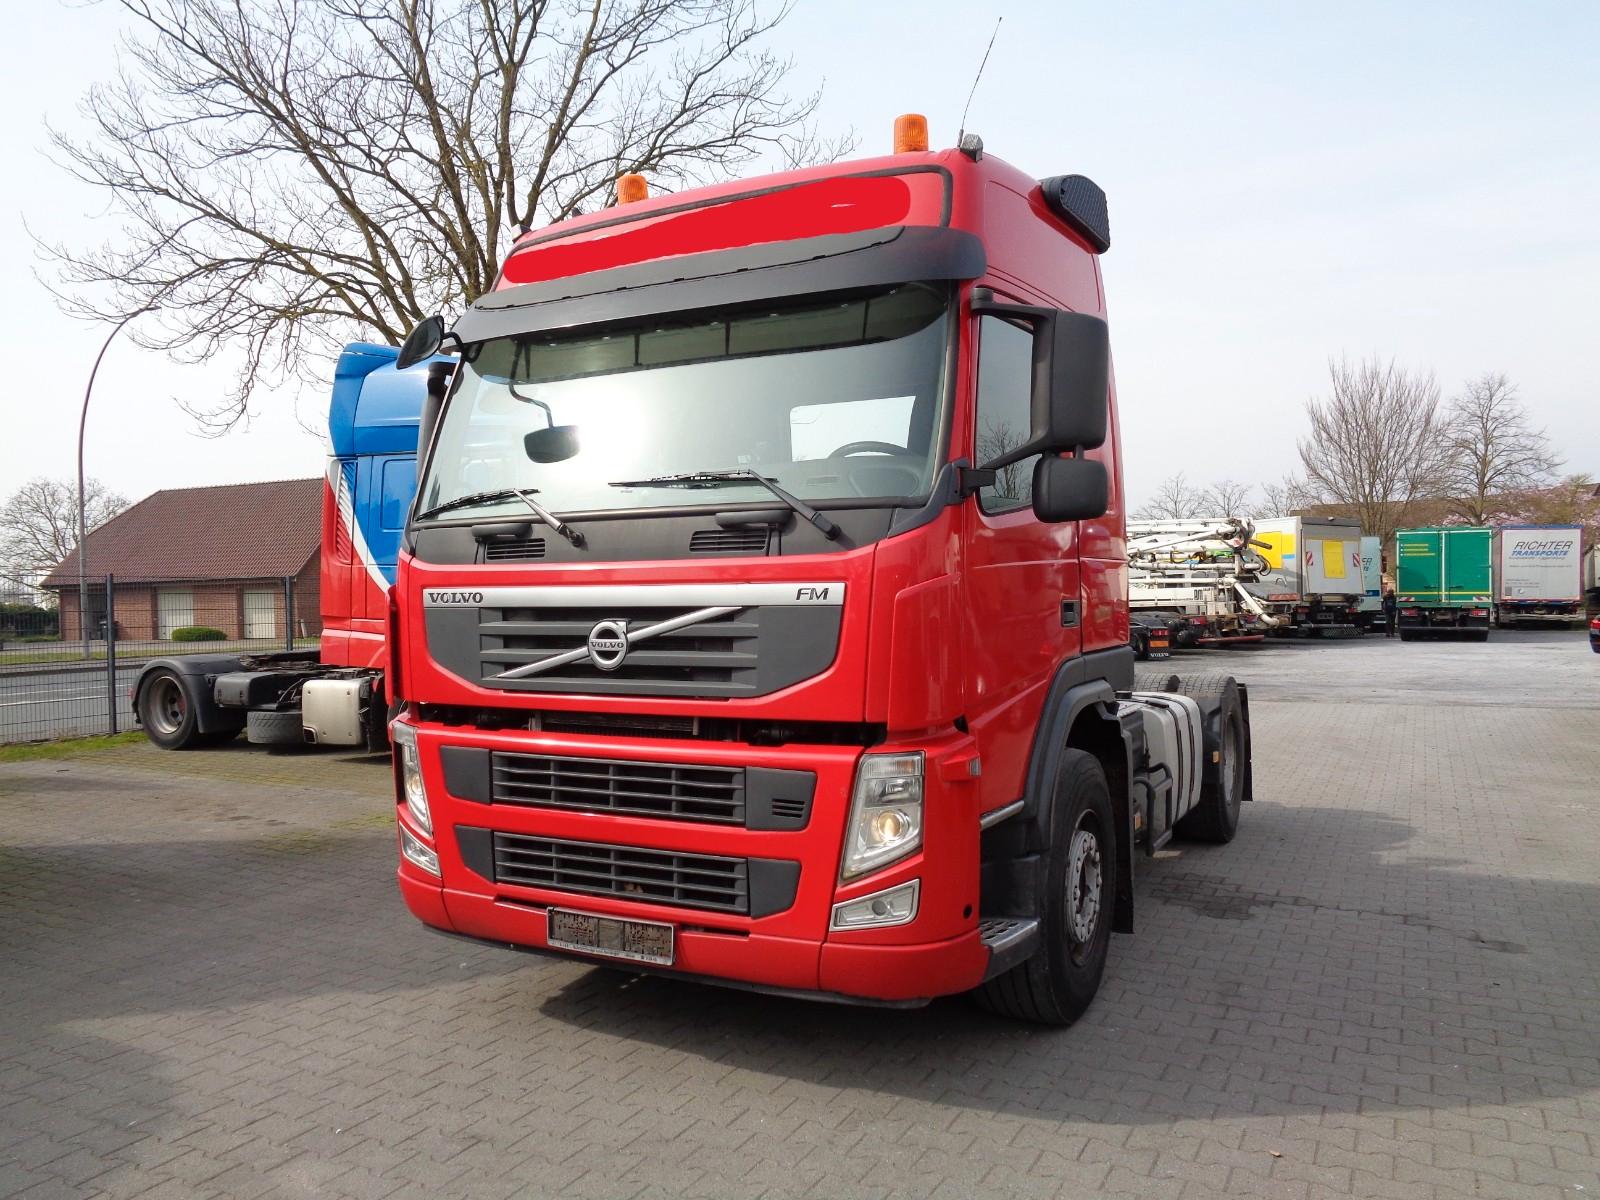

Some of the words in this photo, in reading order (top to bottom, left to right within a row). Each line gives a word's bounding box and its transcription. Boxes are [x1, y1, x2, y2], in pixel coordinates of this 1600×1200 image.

[1514, 541, 1573, 550] RICHTER
[428, 592, 484, 604] VOLVO
[796, 587, 829, 600] FM
[590, 641, 625, 649] VOLVO
